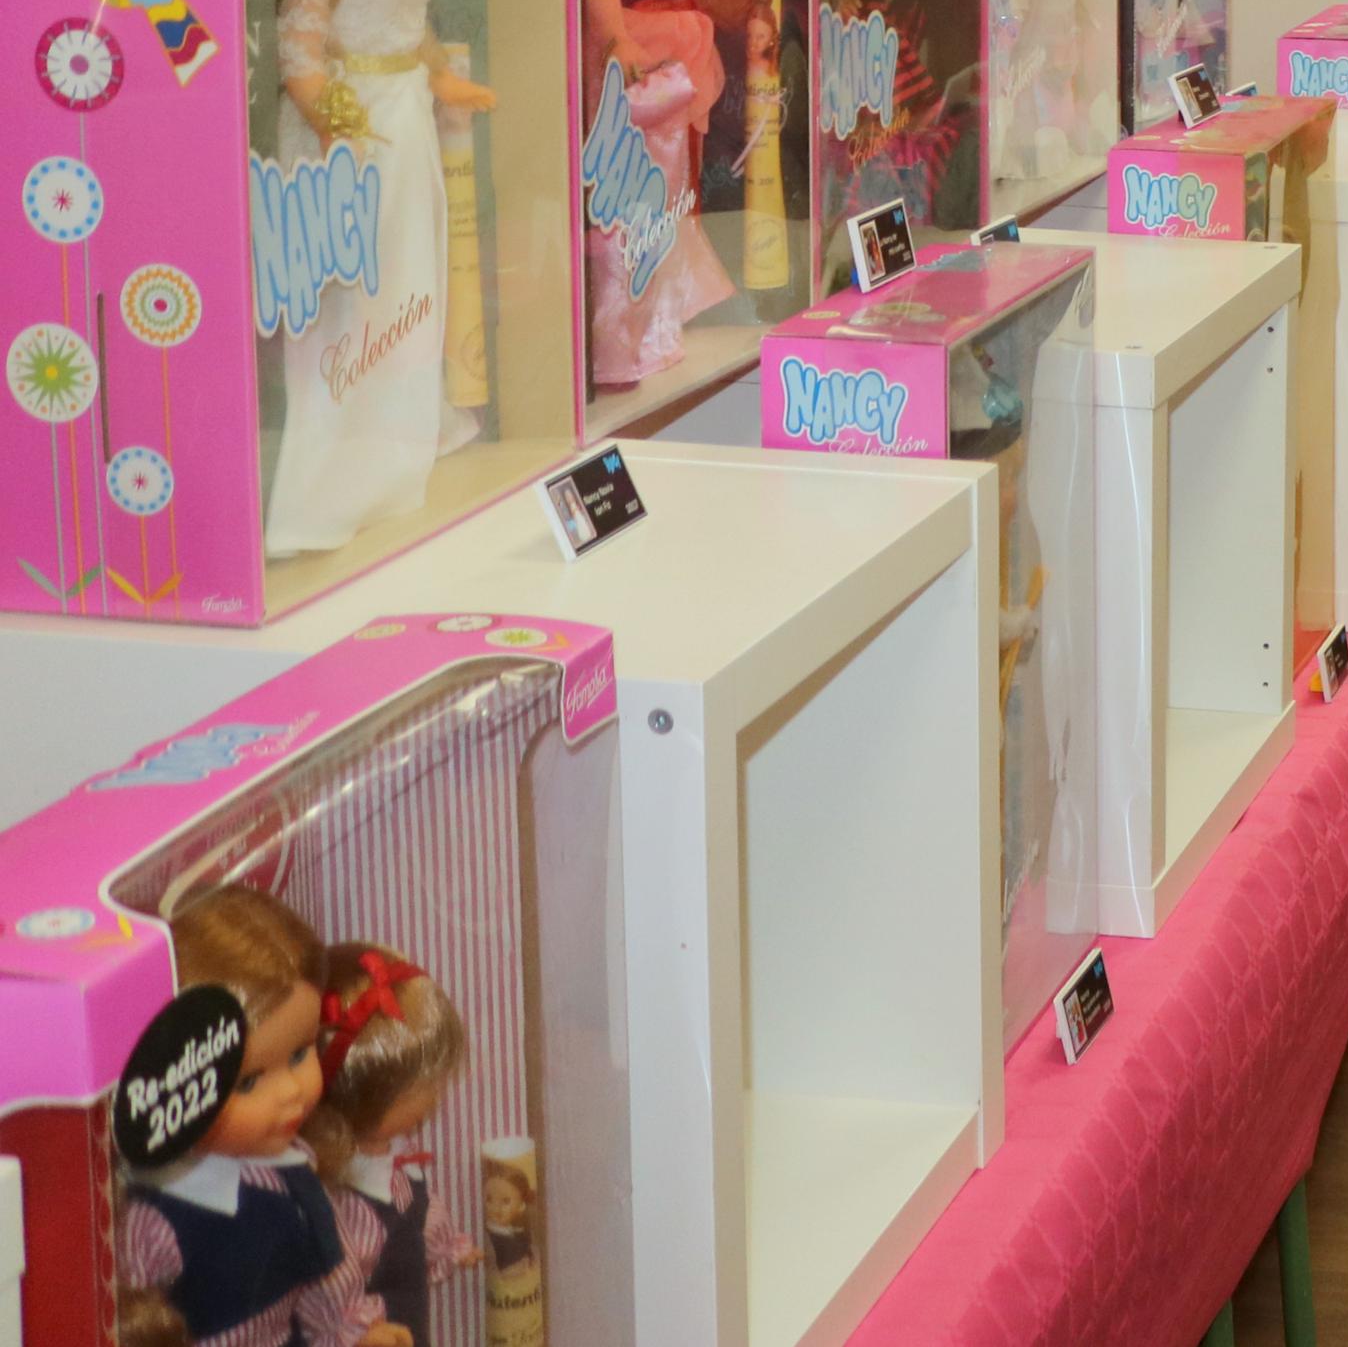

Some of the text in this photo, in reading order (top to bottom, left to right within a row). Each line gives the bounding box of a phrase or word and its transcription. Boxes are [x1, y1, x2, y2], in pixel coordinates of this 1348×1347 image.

[820, 2, 899, 140] NANCY
[249, 140, 381, 338] NANCY
[1124, 164, 1217, 230] NANCY
[319, 290, 434, 404] Colección
[782, 355, 908, 445] NANCY
[127, 1015, 240, 1122] Re-edición
[146, 1070, 219, 1151] 2022
